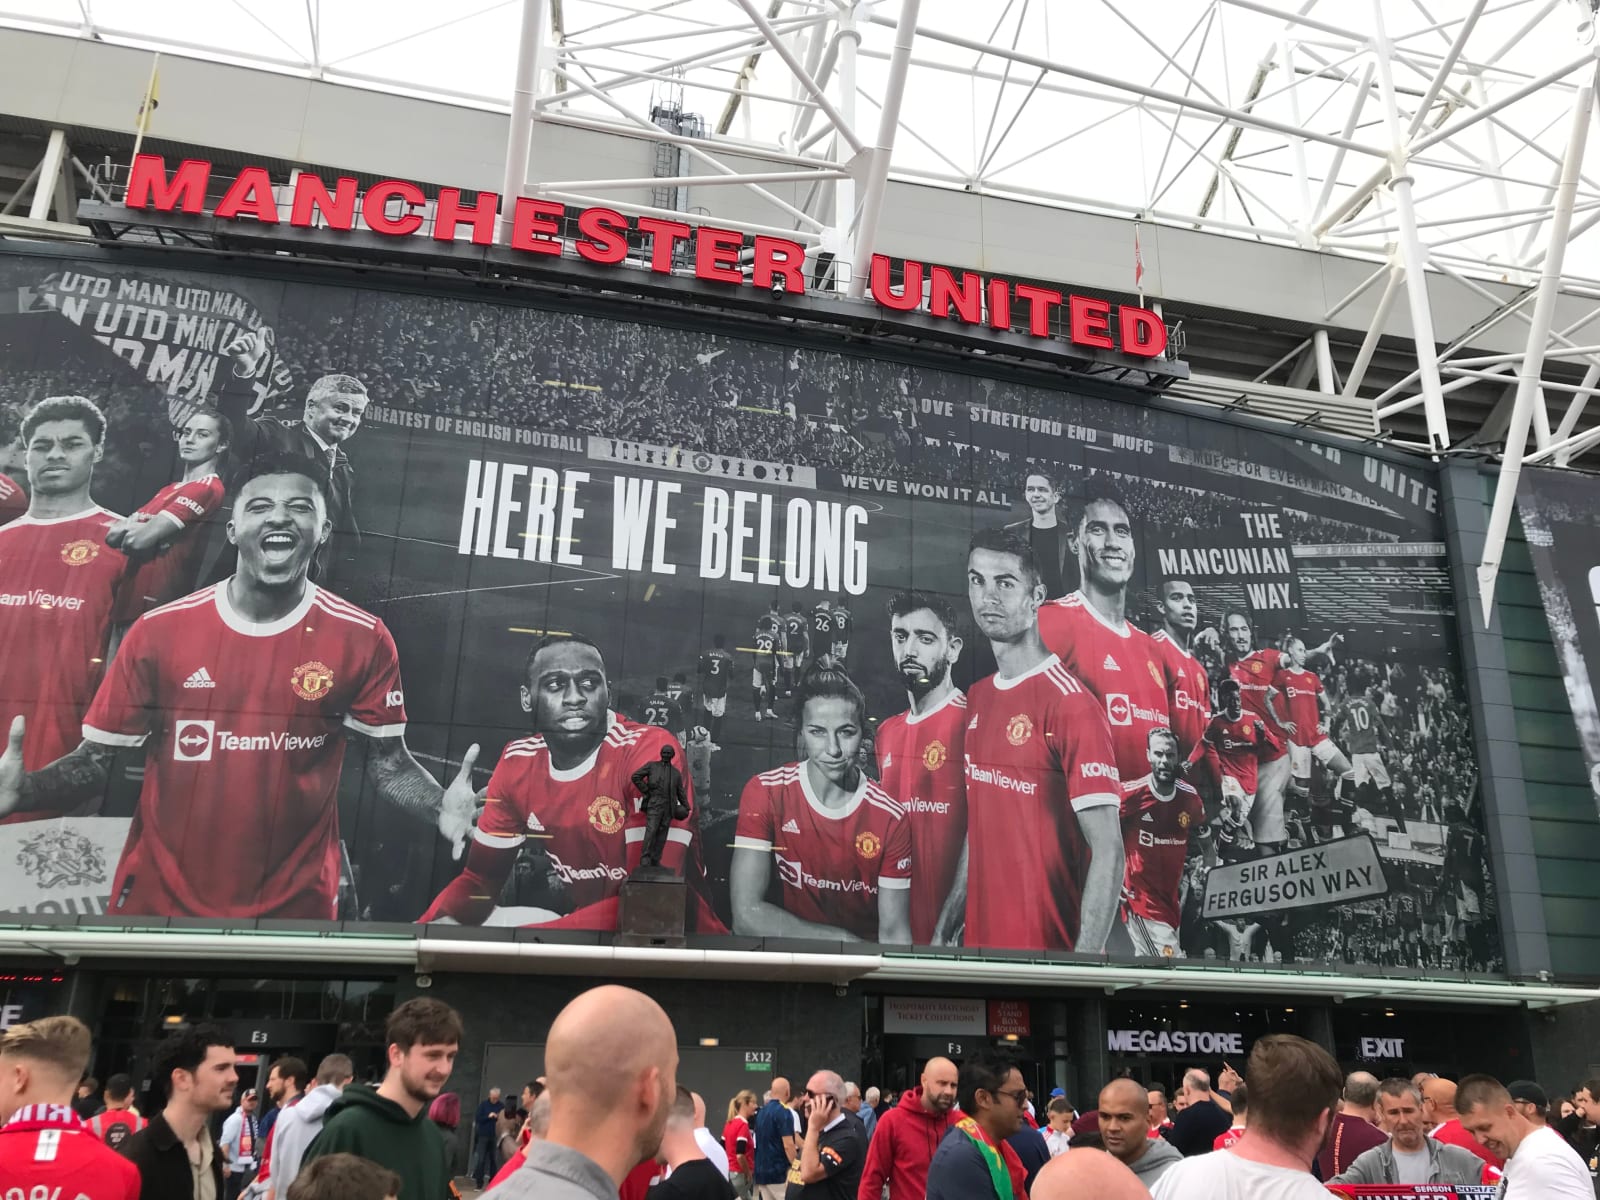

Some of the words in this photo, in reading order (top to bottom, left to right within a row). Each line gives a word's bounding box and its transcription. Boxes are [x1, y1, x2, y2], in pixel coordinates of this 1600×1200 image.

[125, 152, 806, 295] MANCHESTER
[871, 253, 1168, 358] UNITED
[59, 271, 112, 298] UTD
[117, 278, 170, 307] MAN
[175, 287, 211, 313] UTD
[211, 291, 248, 320] MAN
[94, 302, 169, 341] UTD
[172, 313, 220, 352] MAN
[146, 344, 219, 405] MAN
[364, 403, 431, 429] GREATEST
[435, 415, 453, 433] OF
[455, 418, 511, 442] ENGLISH
[515, 428, 584, 453] FOOTBALL
[970, 406, 1062, 437] STRETFORD
[1067, 424, 1097, 443] END
[1112, 433, 1154, 454] MUFC
[841, 473, 898, 493] WE'VE
[904, 481, 949, 499] WON
[953, 487, 972, 501] IT
[976, 490, 1012, 507] ALL
[458, 459, 590, 566] HERE
[612, 475, 682, 575] WE
[700, 486, 869, 596] BELONG
[1240, 513, 1283, 539] THE
[1158, 547, 1291, 576] MANCUNIAN
[0, 588, 85, 611] amViewer
[1247, 582, 1299, 610] WAY.
[789, 621, 799, 635] 2
[815, 617, 830, 632] 26
[710, 659, 720, 675] 3
[183, 680, 216, 689] adidas
[644, 707, 670, 726] 23
[1350, 706, 1370, 732] 10
[216, 731, 329, 752] TeamViewer
[969, 763, 1037, 796] TeamViewer
[1463, 834, 1474, 857] 7
[1240, 864, 1269, 884] SIR
[1275, 851, 1327, 878] ALEX
[1207, 877, 1316, 911] FERGUSON
[1321, 865, 1372, 894] WAY
[997, 1009, 1022, 1018] STAND
[1002, 1017, 1019, 1026] BOX
[251, 1030, 268, 1043] E3
[993, 1024, 1027, 1034] HOLDERS
[1107, 1029, 1244, 1055] MEGASTORE
[745, 1051, 772, 1063] EX12
[1360, 1037, 1404, 1058] EXIT
[1414, 1185, 1452, 1194] SEASON
